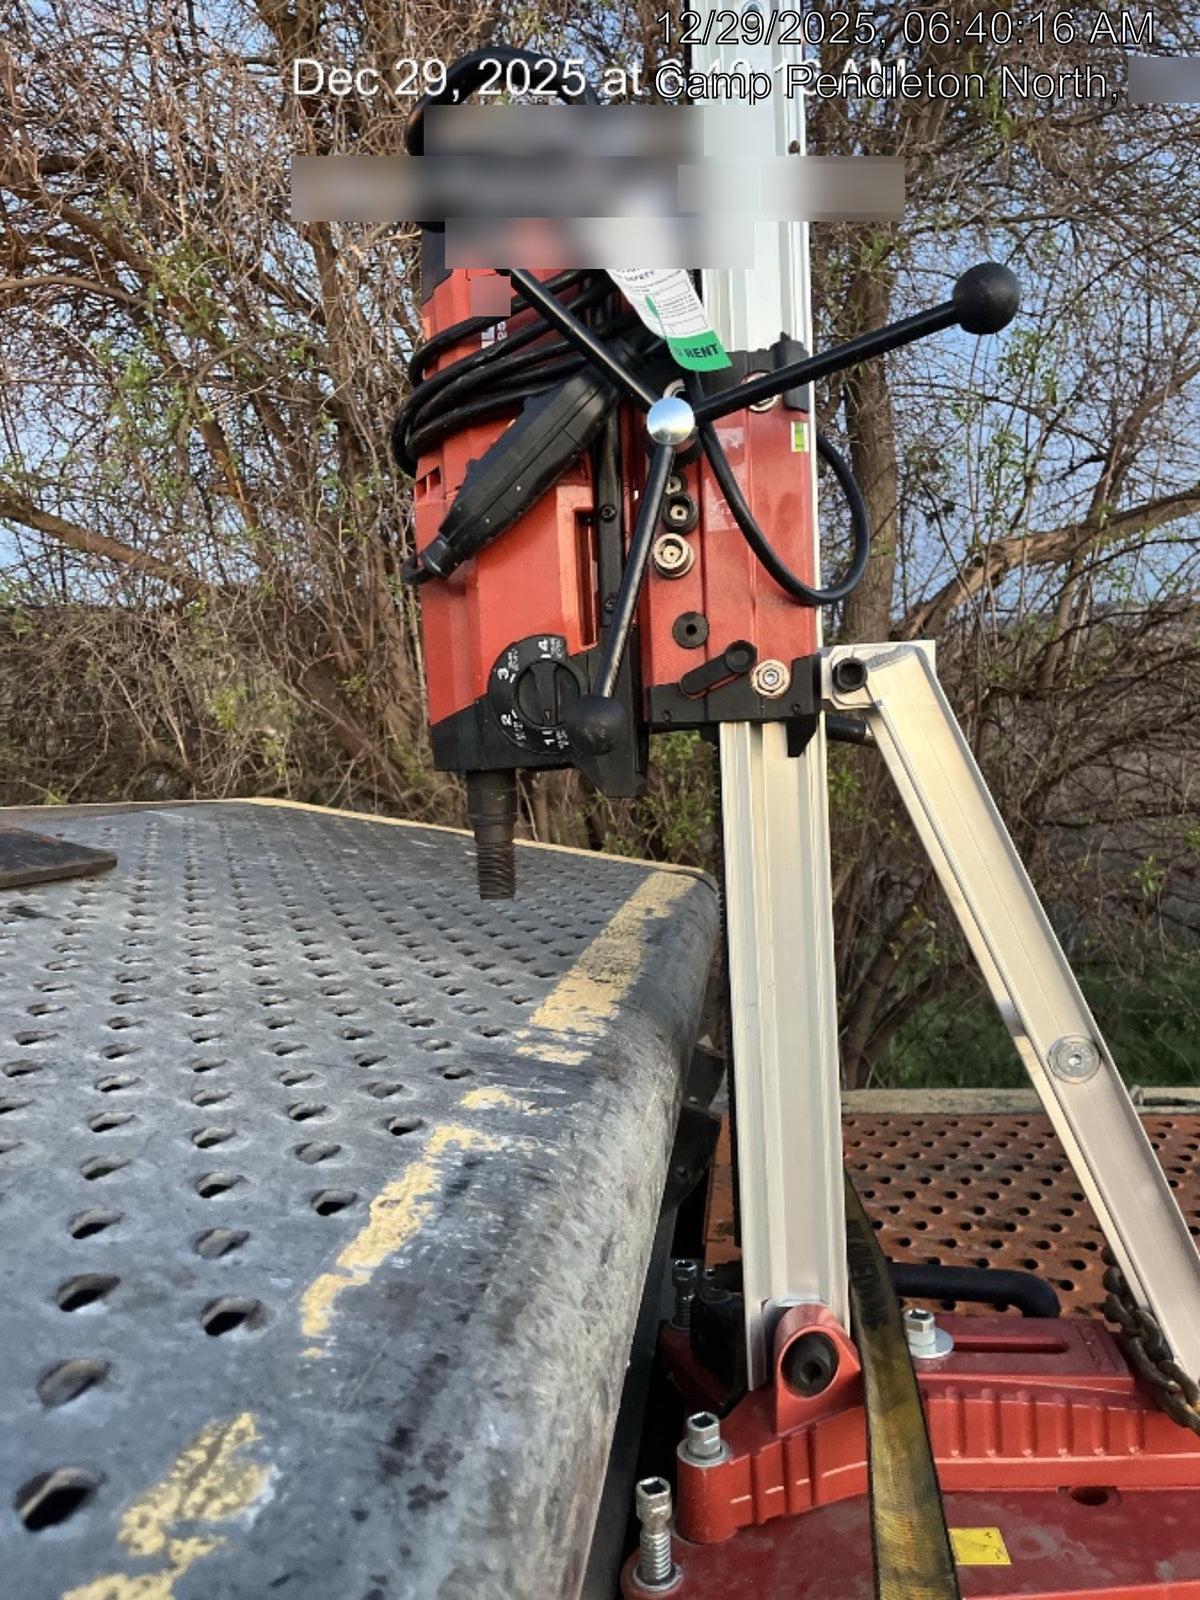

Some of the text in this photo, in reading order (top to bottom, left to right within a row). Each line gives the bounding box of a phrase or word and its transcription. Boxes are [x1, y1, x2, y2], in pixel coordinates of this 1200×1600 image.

[684, 343, 720, 358] RENT
[538, 639, 549, 651] 4
[497, 668, 509, 680] 3
[501, 714, 512, 726] 2
